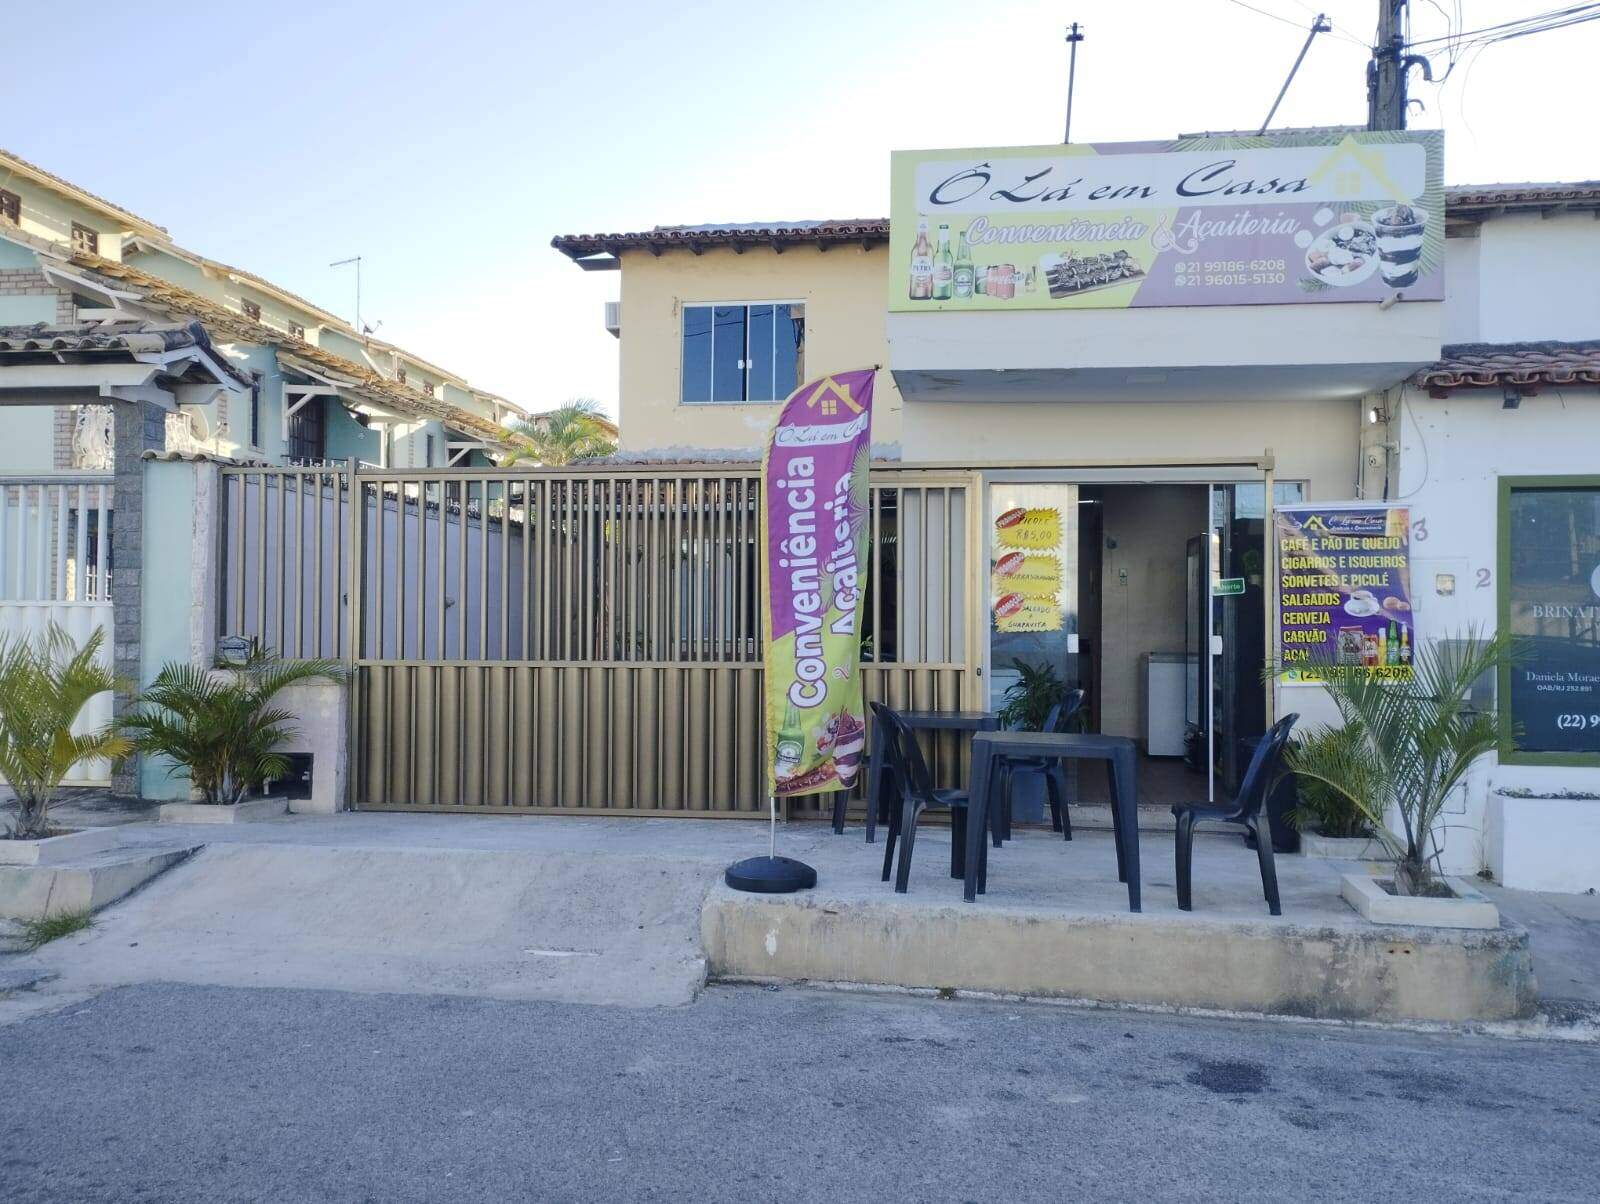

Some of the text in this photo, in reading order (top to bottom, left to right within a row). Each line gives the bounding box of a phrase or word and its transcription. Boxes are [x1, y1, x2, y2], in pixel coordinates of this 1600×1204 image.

[929, 159, 1311, 205] Ô Lá em Casa
[965, 215, 1148, 246] Conveniência
[1175, 209, 1302, 242] Açaiteria
[1187, 259, 1286, 273] 21 99186-6208
[1187, 272, 1285, 286] 21 96015-5130
[1280, 535, 1400, 551] CAFÉ E PÃO DE QUEIJO
[1281, 556, 1406, 570] CIGARROS E ISQUEIROS
[777, 456, 827, 708] Conveniência
[1282, 570, 1389, 588] SORVETES E PICOLÉ
[1476, 568, 1491, 591] 2
[1282, 593, 1341, 606] SALGADOS
[1282, 612, 1331, 625] CERVEJA
[1283, 628, 1327, 643] CARVÃO
[1557, 714, 1587, 730] (22)
